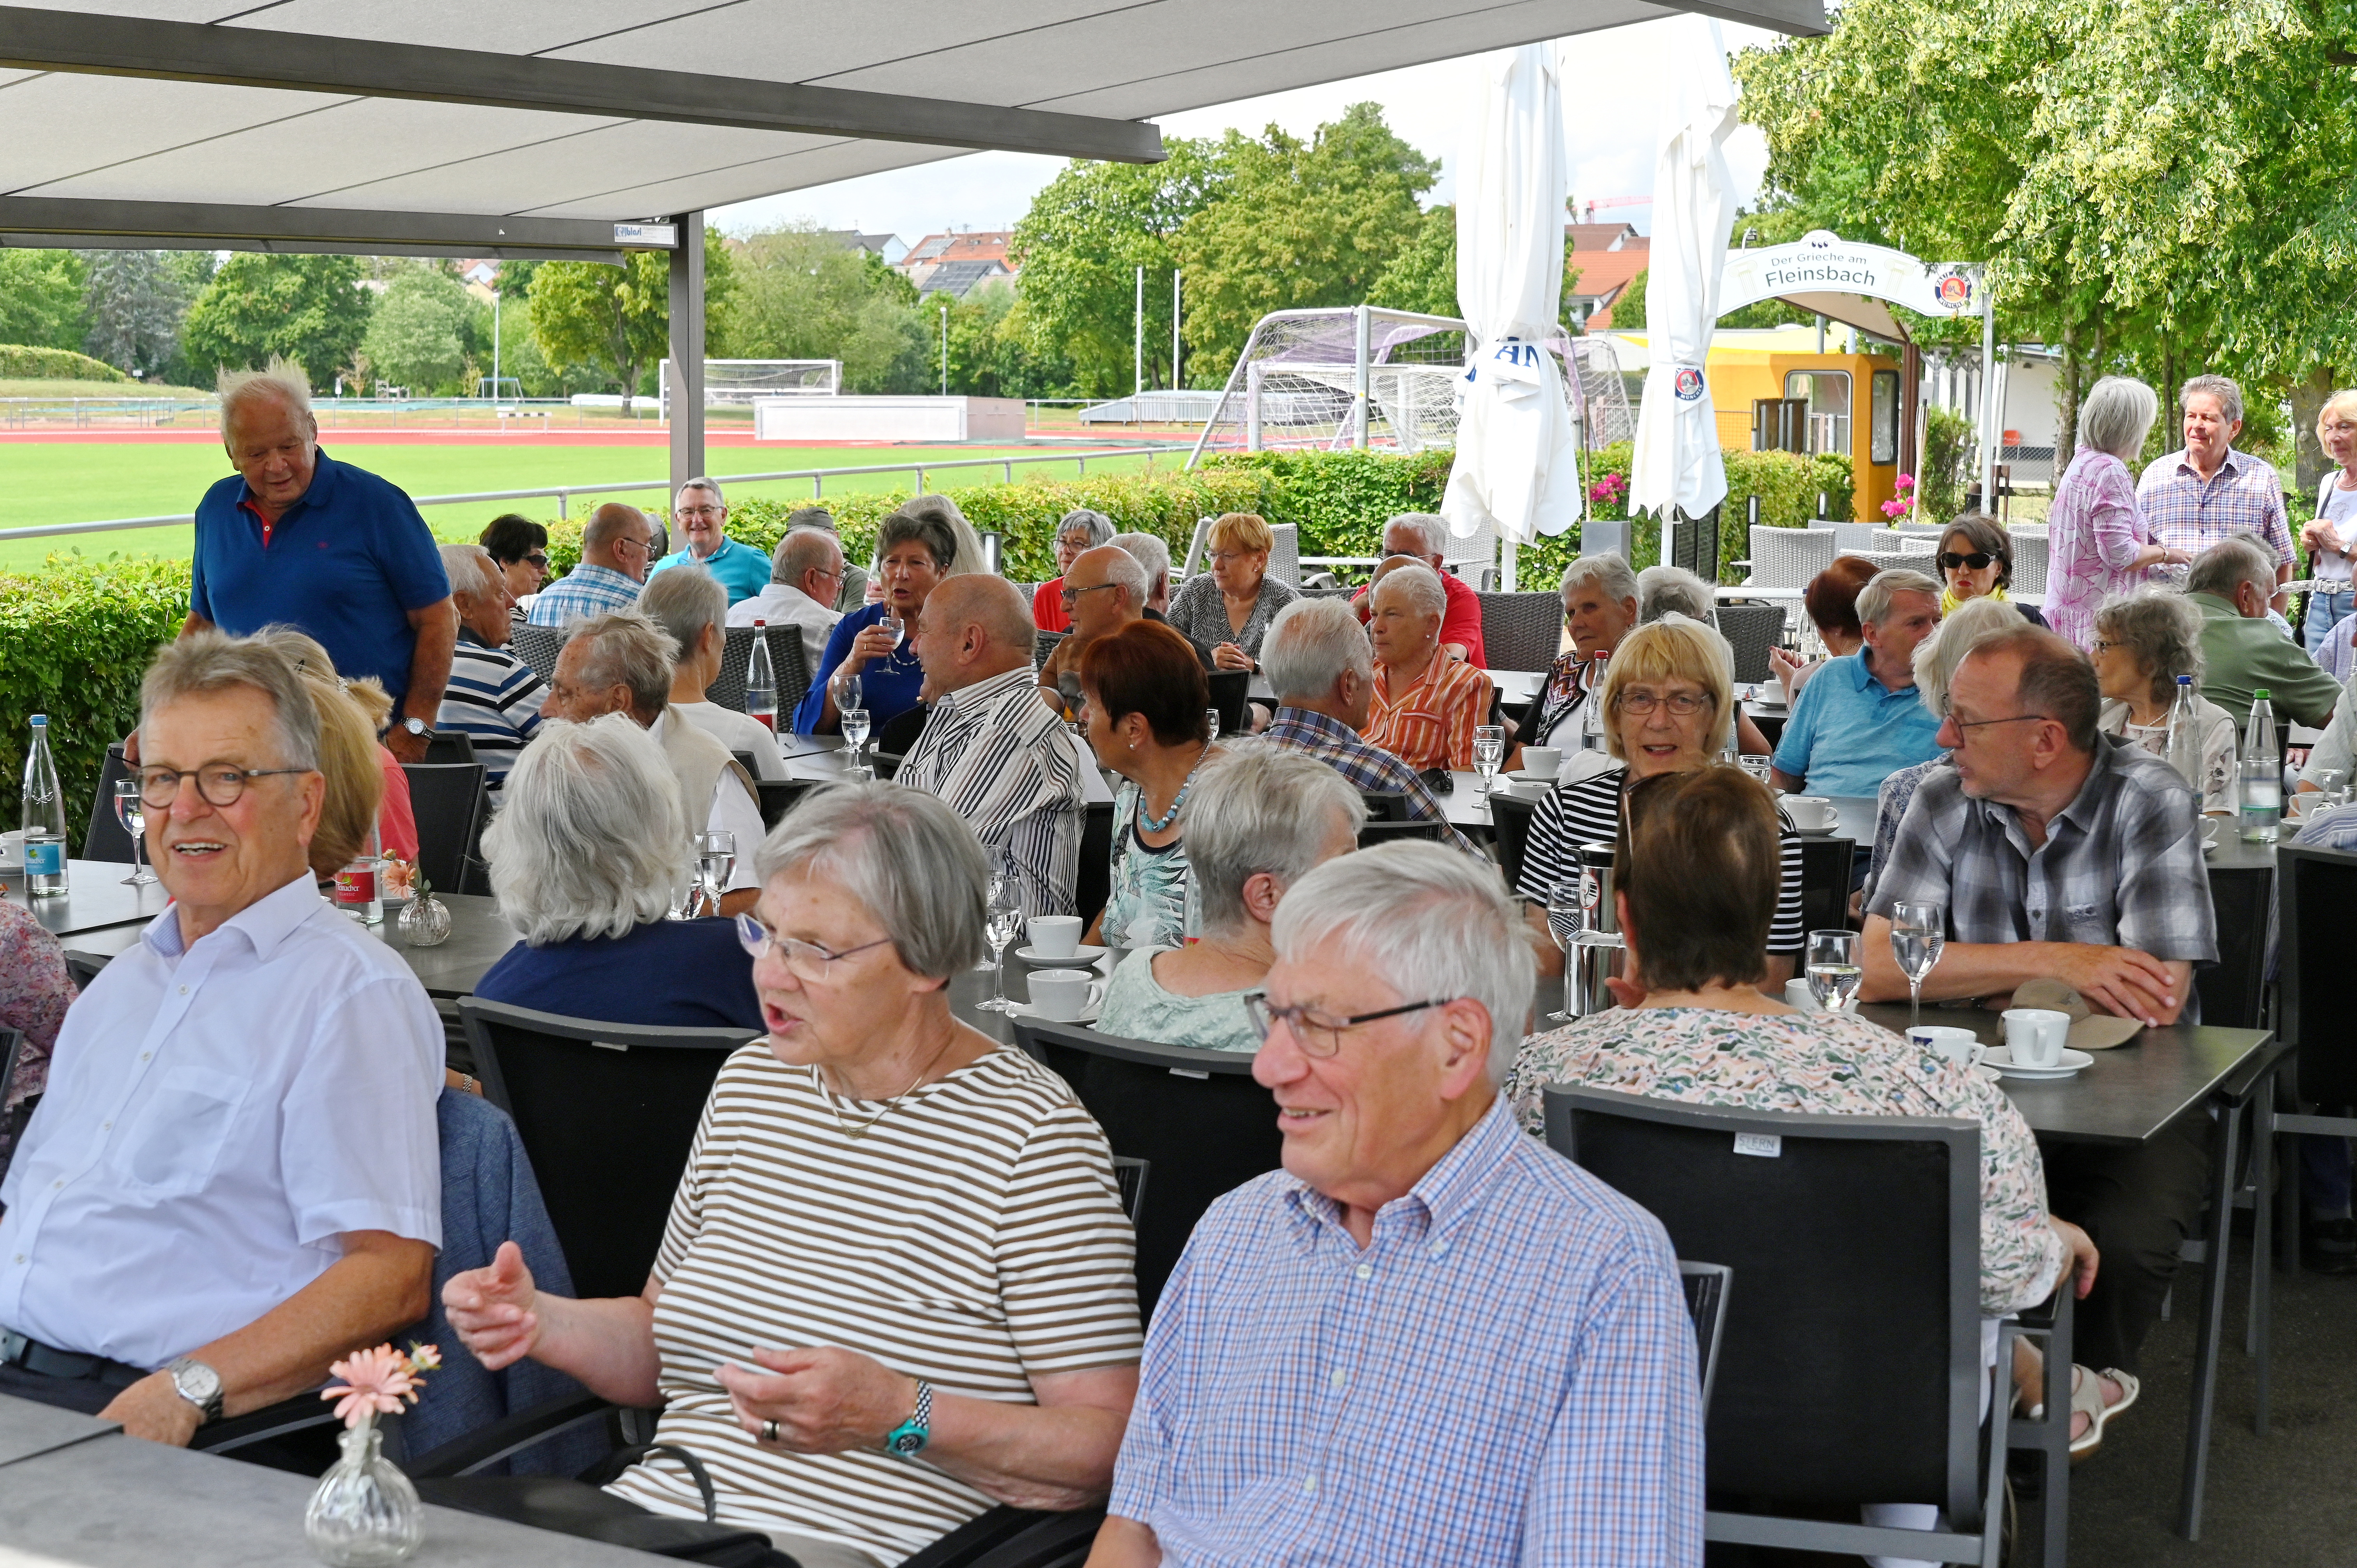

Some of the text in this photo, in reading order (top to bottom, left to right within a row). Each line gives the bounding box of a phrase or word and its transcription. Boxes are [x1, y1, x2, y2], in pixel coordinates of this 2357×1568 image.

[1772, 253, 1866, 266] Der Grieche am
[1765, 266, 1875, 287] Fleinsbach
